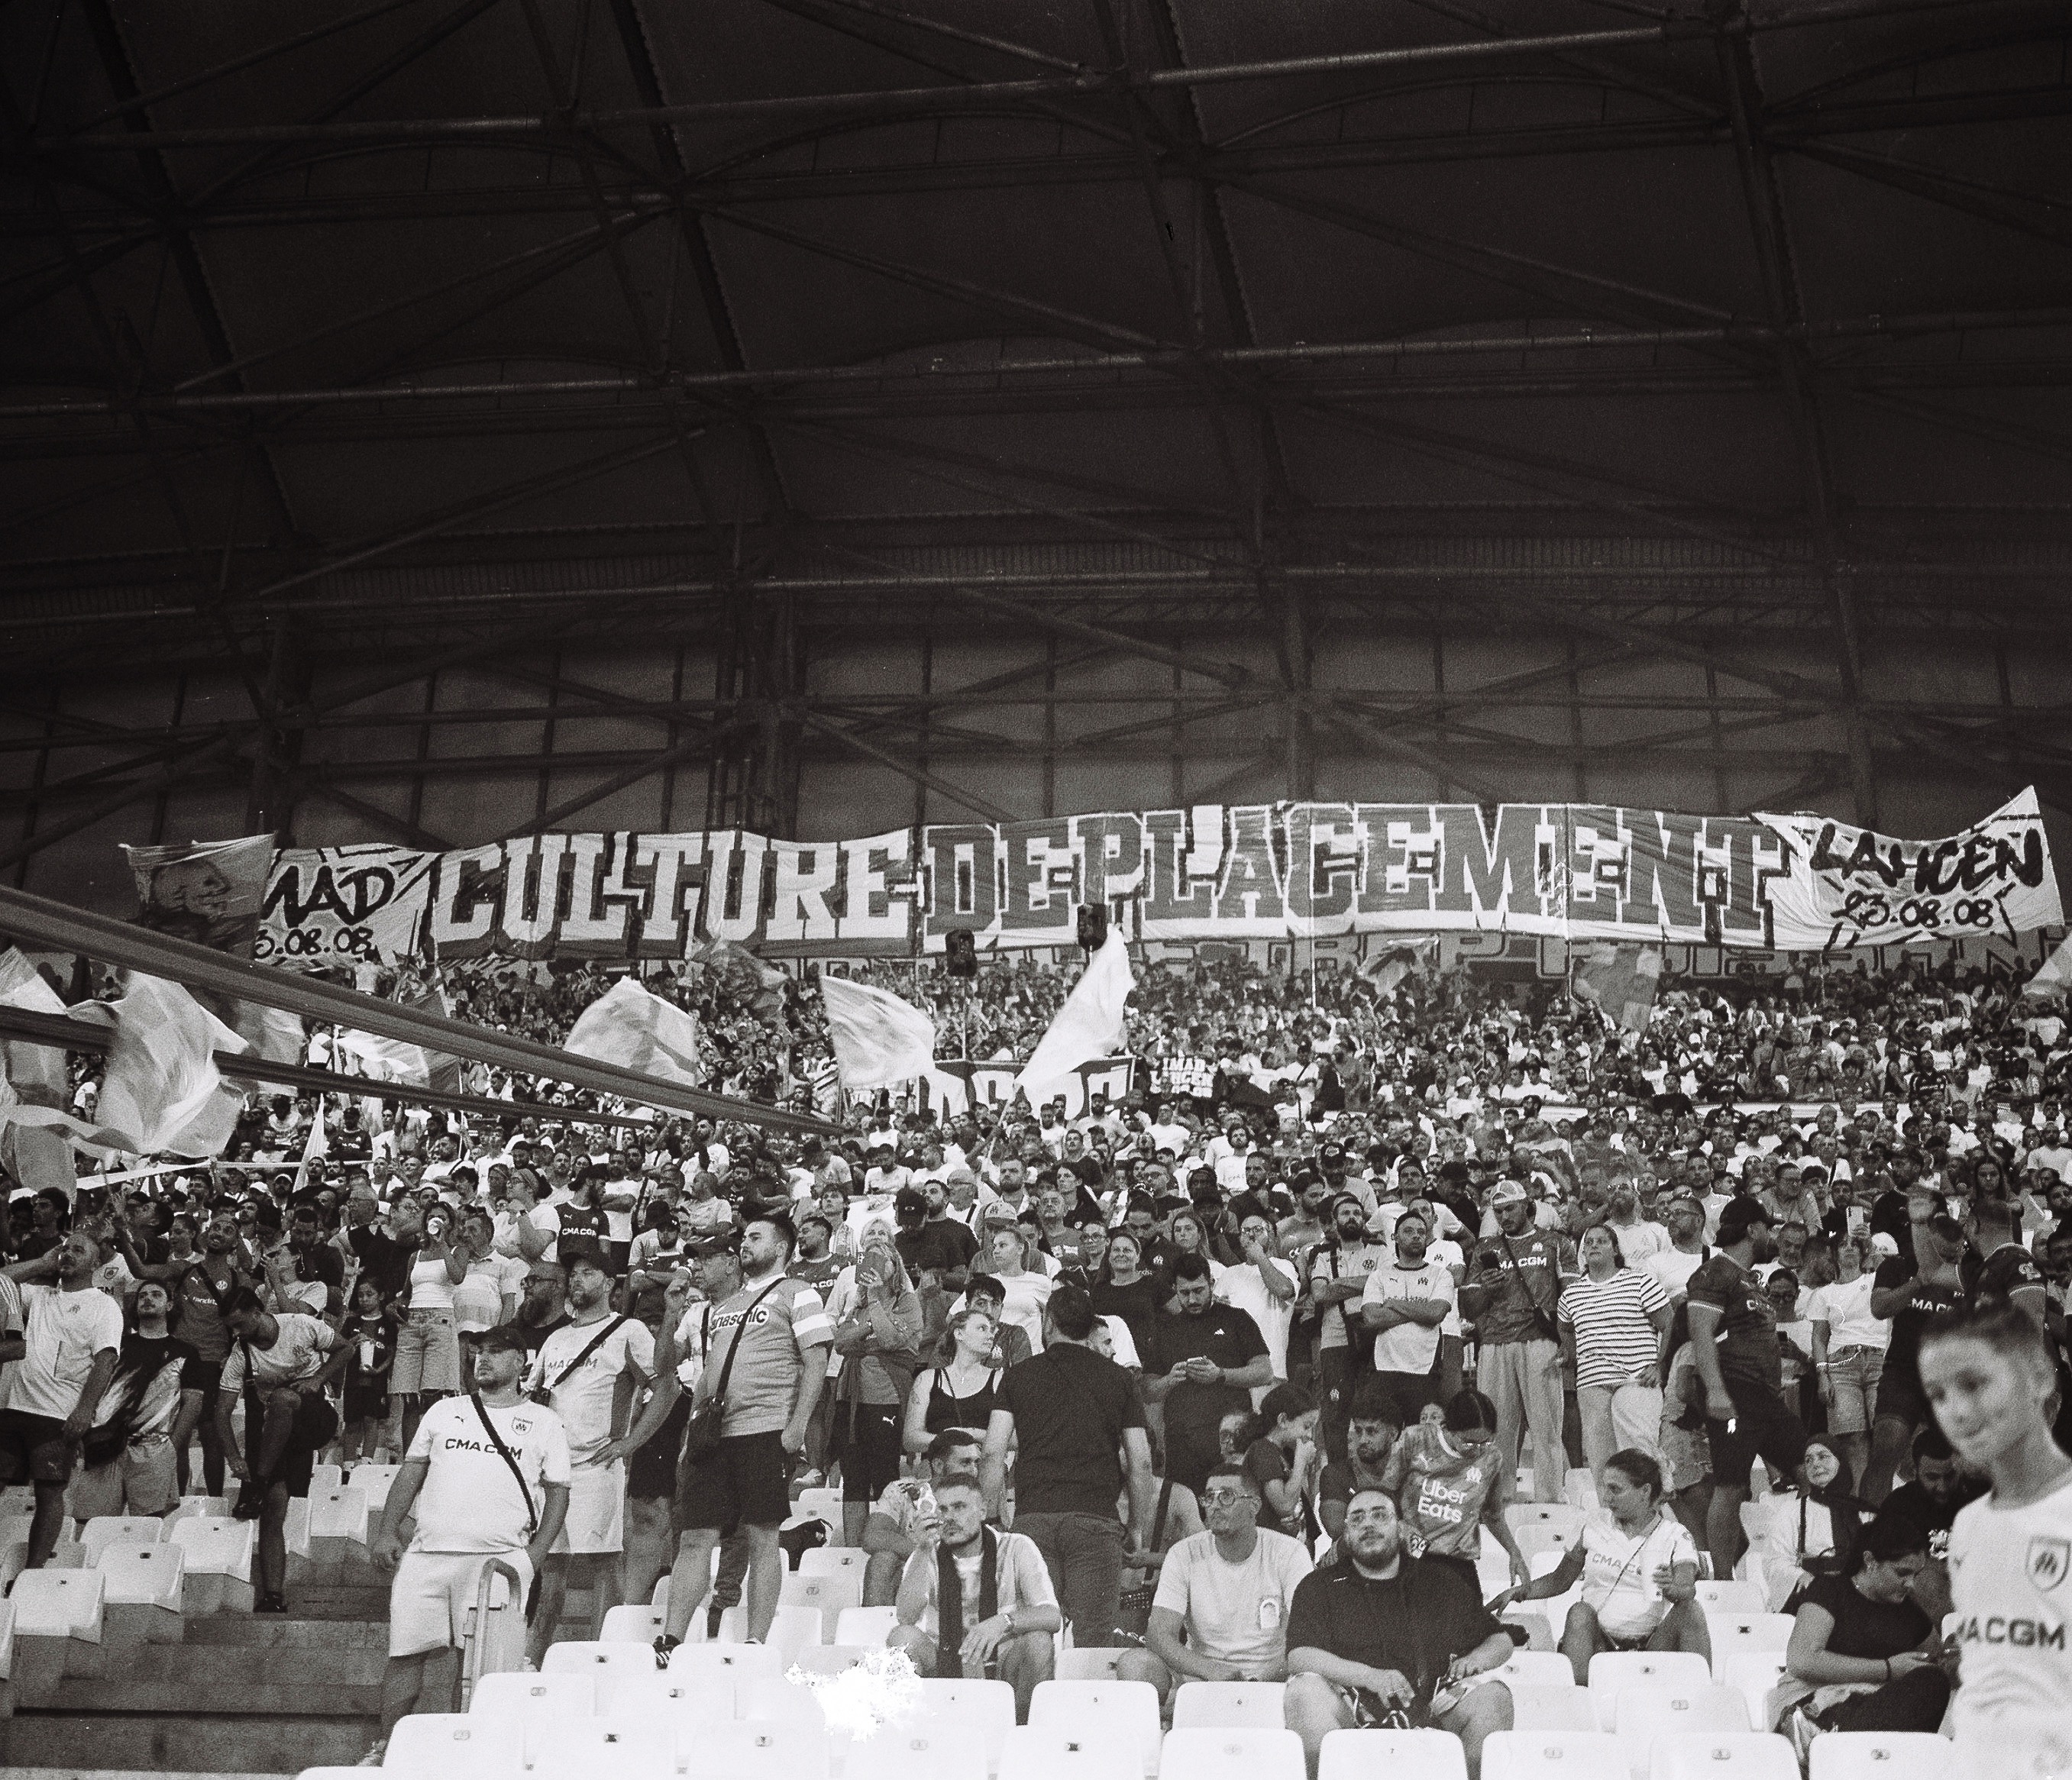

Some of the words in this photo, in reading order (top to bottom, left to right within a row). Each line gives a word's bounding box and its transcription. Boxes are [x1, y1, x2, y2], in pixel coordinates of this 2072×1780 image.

[431, 828, 910, 943] CULTURE
[926, 804, 1785, 941] DEPLACEMENT
[259, 864, 396, 929] MAD
[254, 928, 373, 959] 3.08.08
[1518, 1256, 1547, 1268] CGM
[1912, 1297, 1933, 1311] MA
[445, 1438, 481, 1451] CMA
[484, 1444, 522, 1460] CM
[1421, 1478, 1467, 1504] Uber
[1417, 1495, 1463, 1523] Eats
[1592, 1553, 1622, 1569] CMA
[1986, 1617, 2064, 1651] CGM
